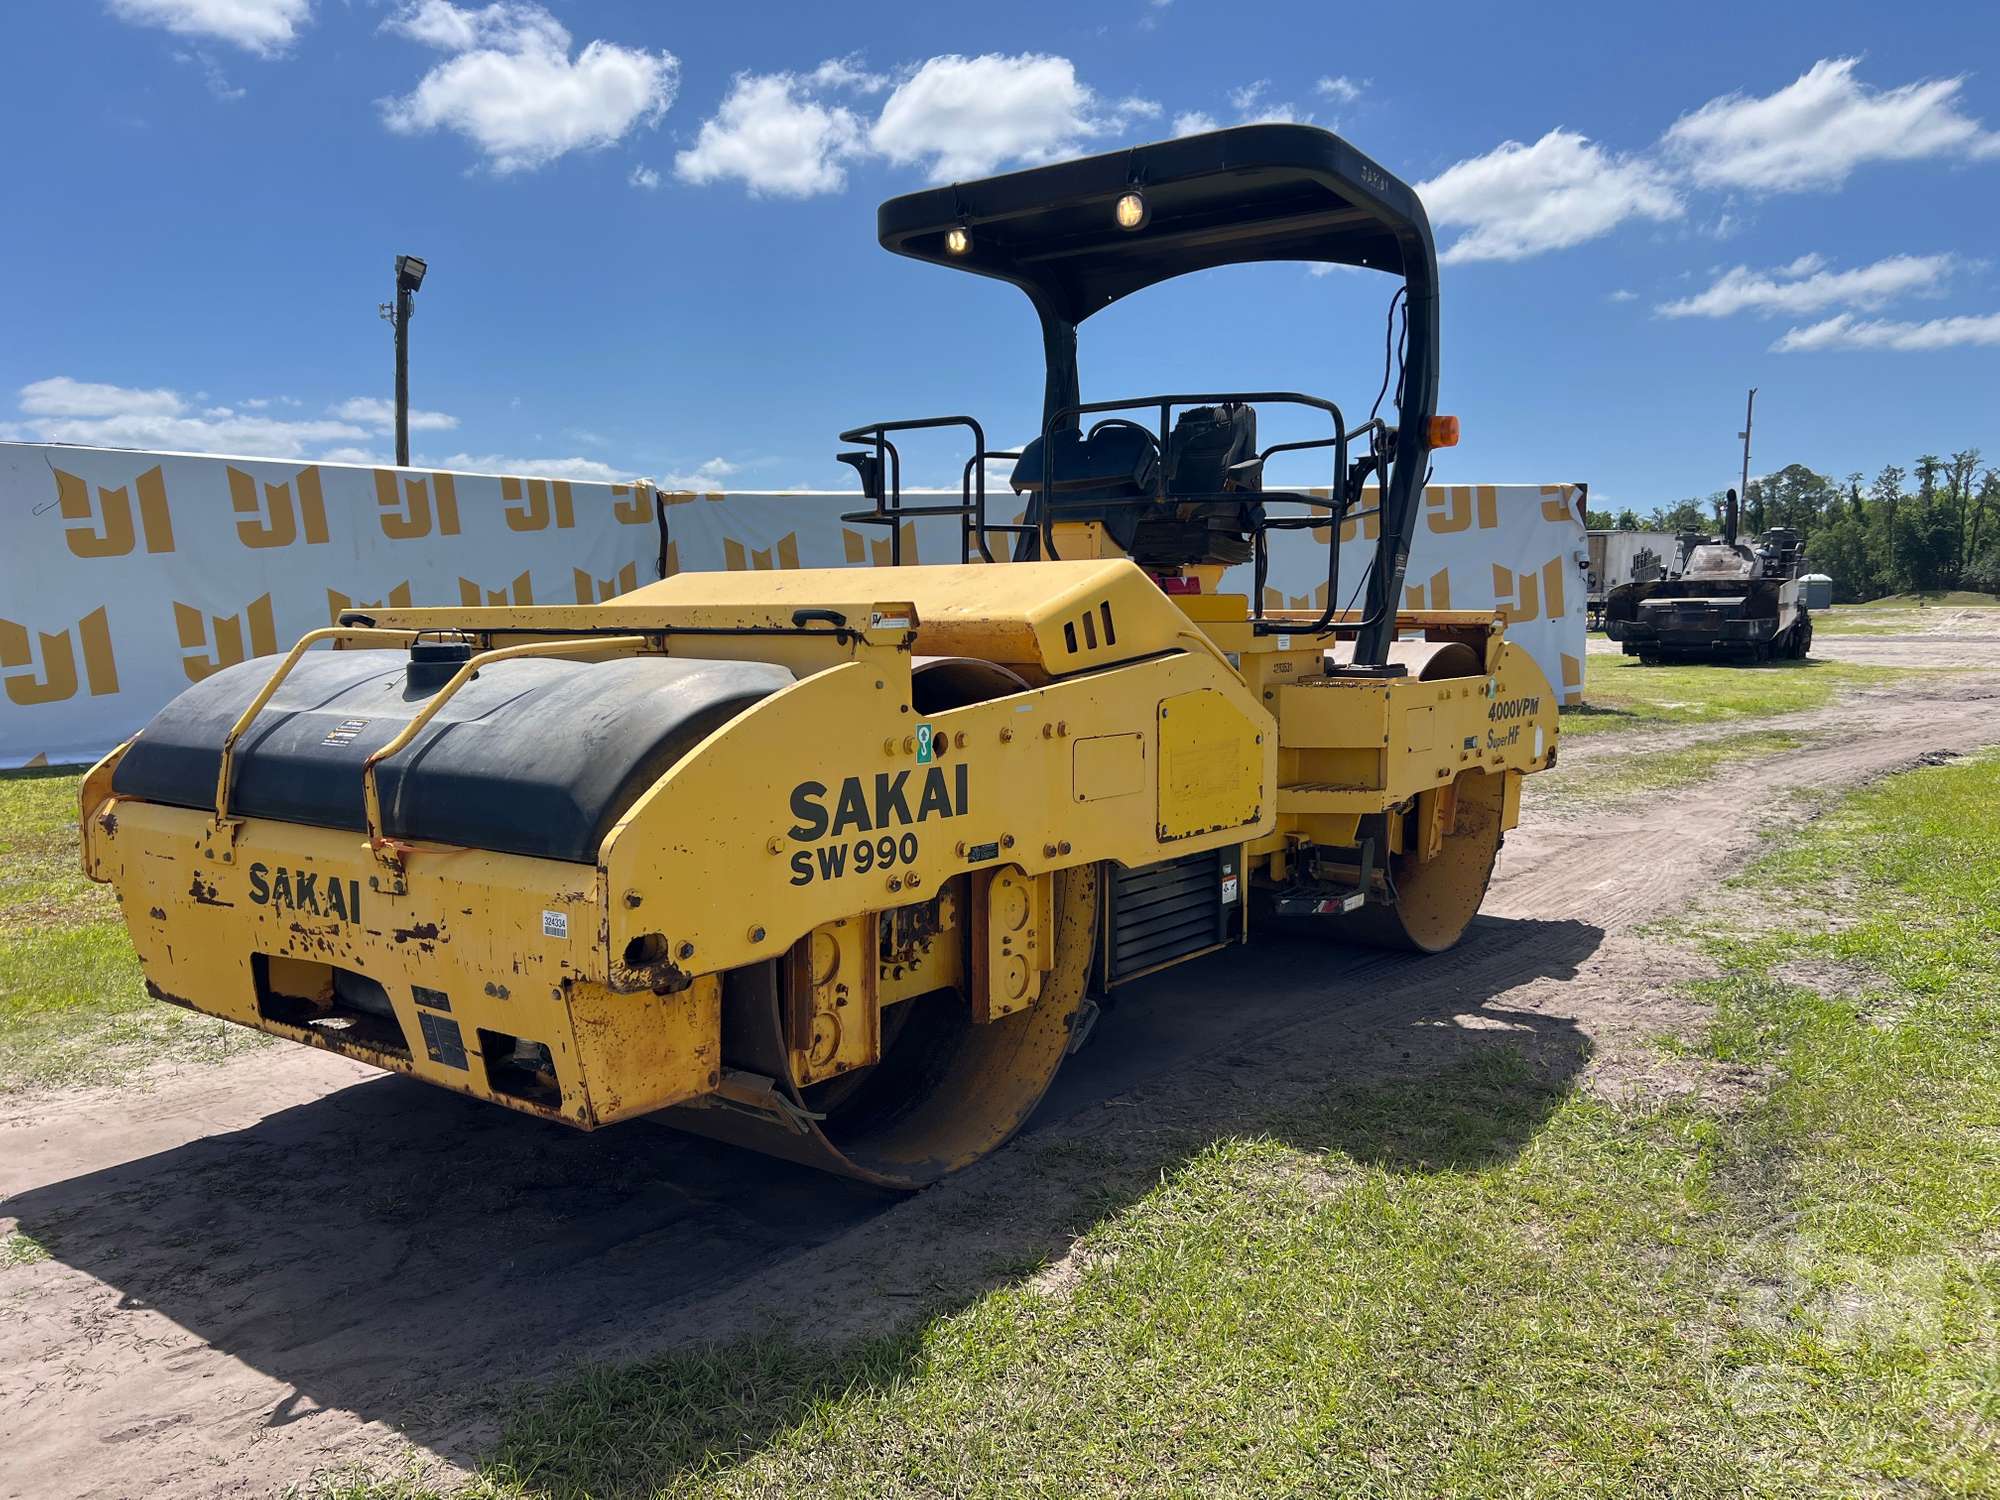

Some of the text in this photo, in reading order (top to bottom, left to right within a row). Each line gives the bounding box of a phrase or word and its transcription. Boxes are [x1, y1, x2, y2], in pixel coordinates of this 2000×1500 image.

[787, 763, 968, 842] SAKAI
[789, 832, 918, 886] SW990
[248, 862, 361, 924] SAKAI
